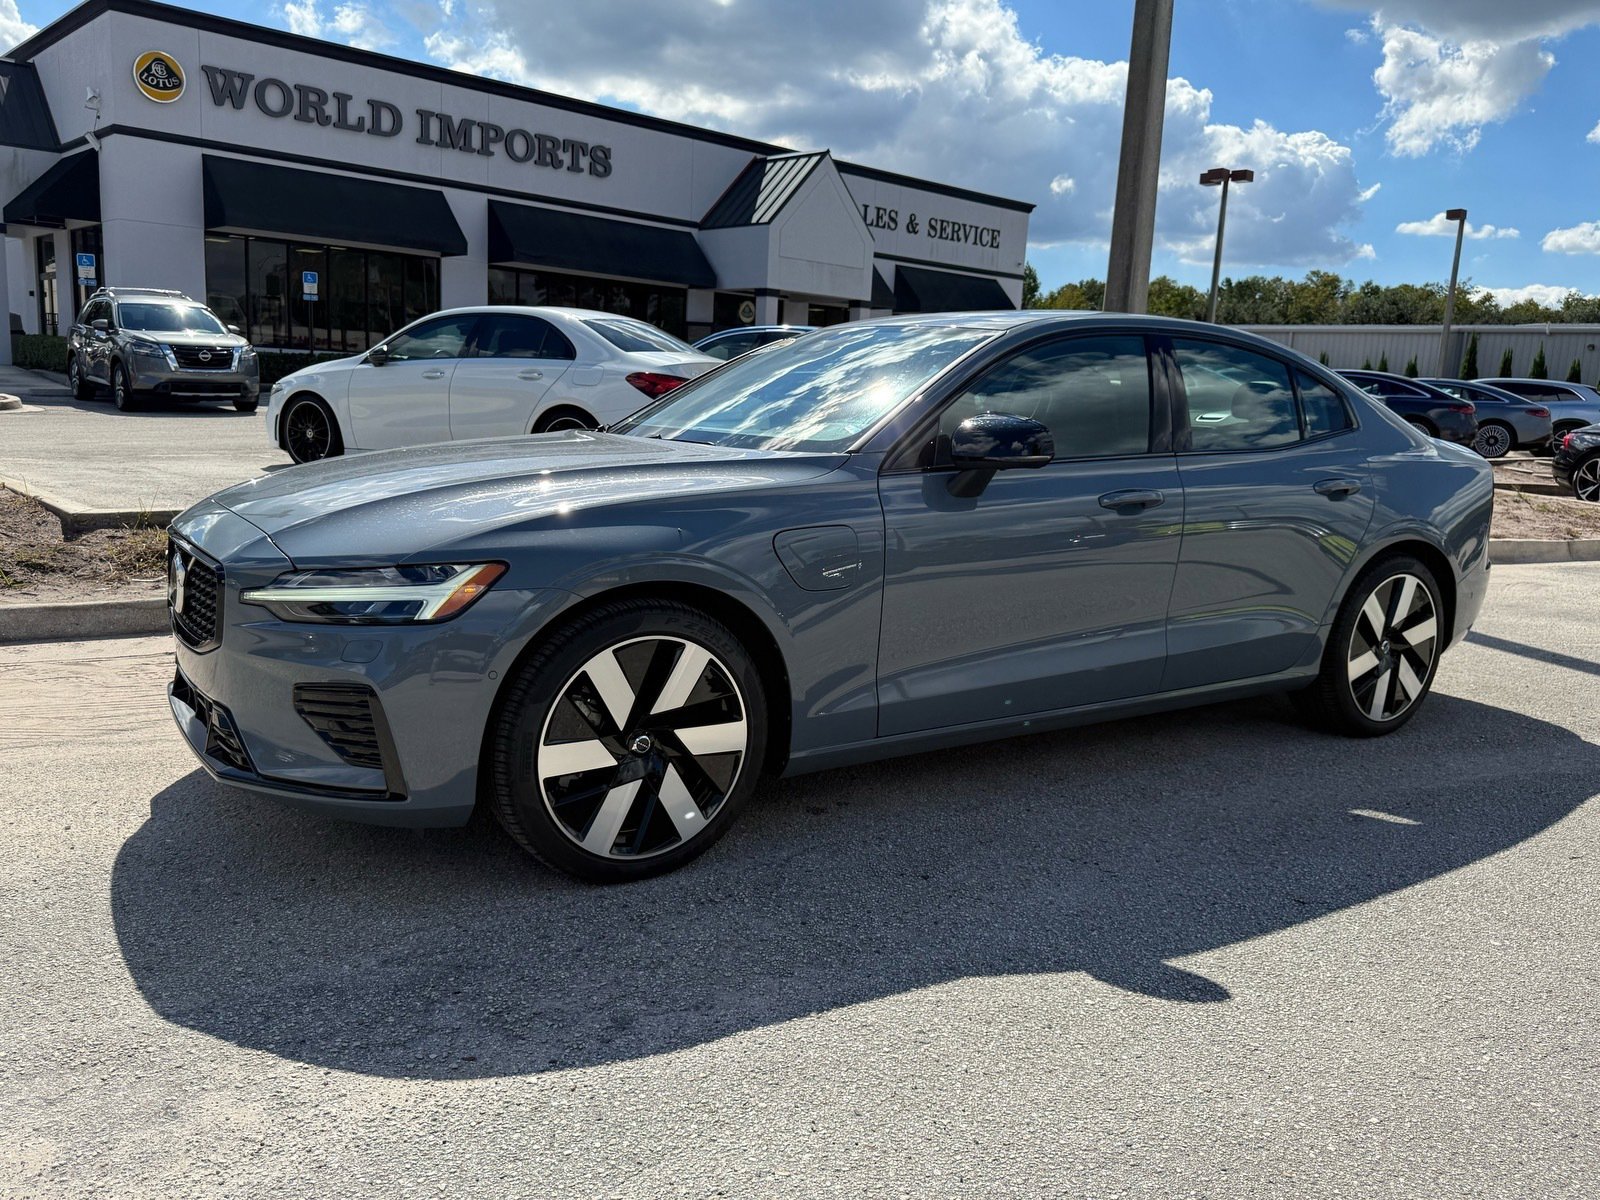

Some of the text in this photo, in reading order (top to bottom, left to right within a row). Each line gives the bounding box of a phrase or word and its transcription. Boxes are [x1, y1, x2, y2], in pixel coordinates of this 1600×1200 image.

[141, 72, 179, 87] LOTUS
[201, 65, 613, 178] WORLD IMPORTS
[861, 204, 1001, 249] LES & SERVICE
